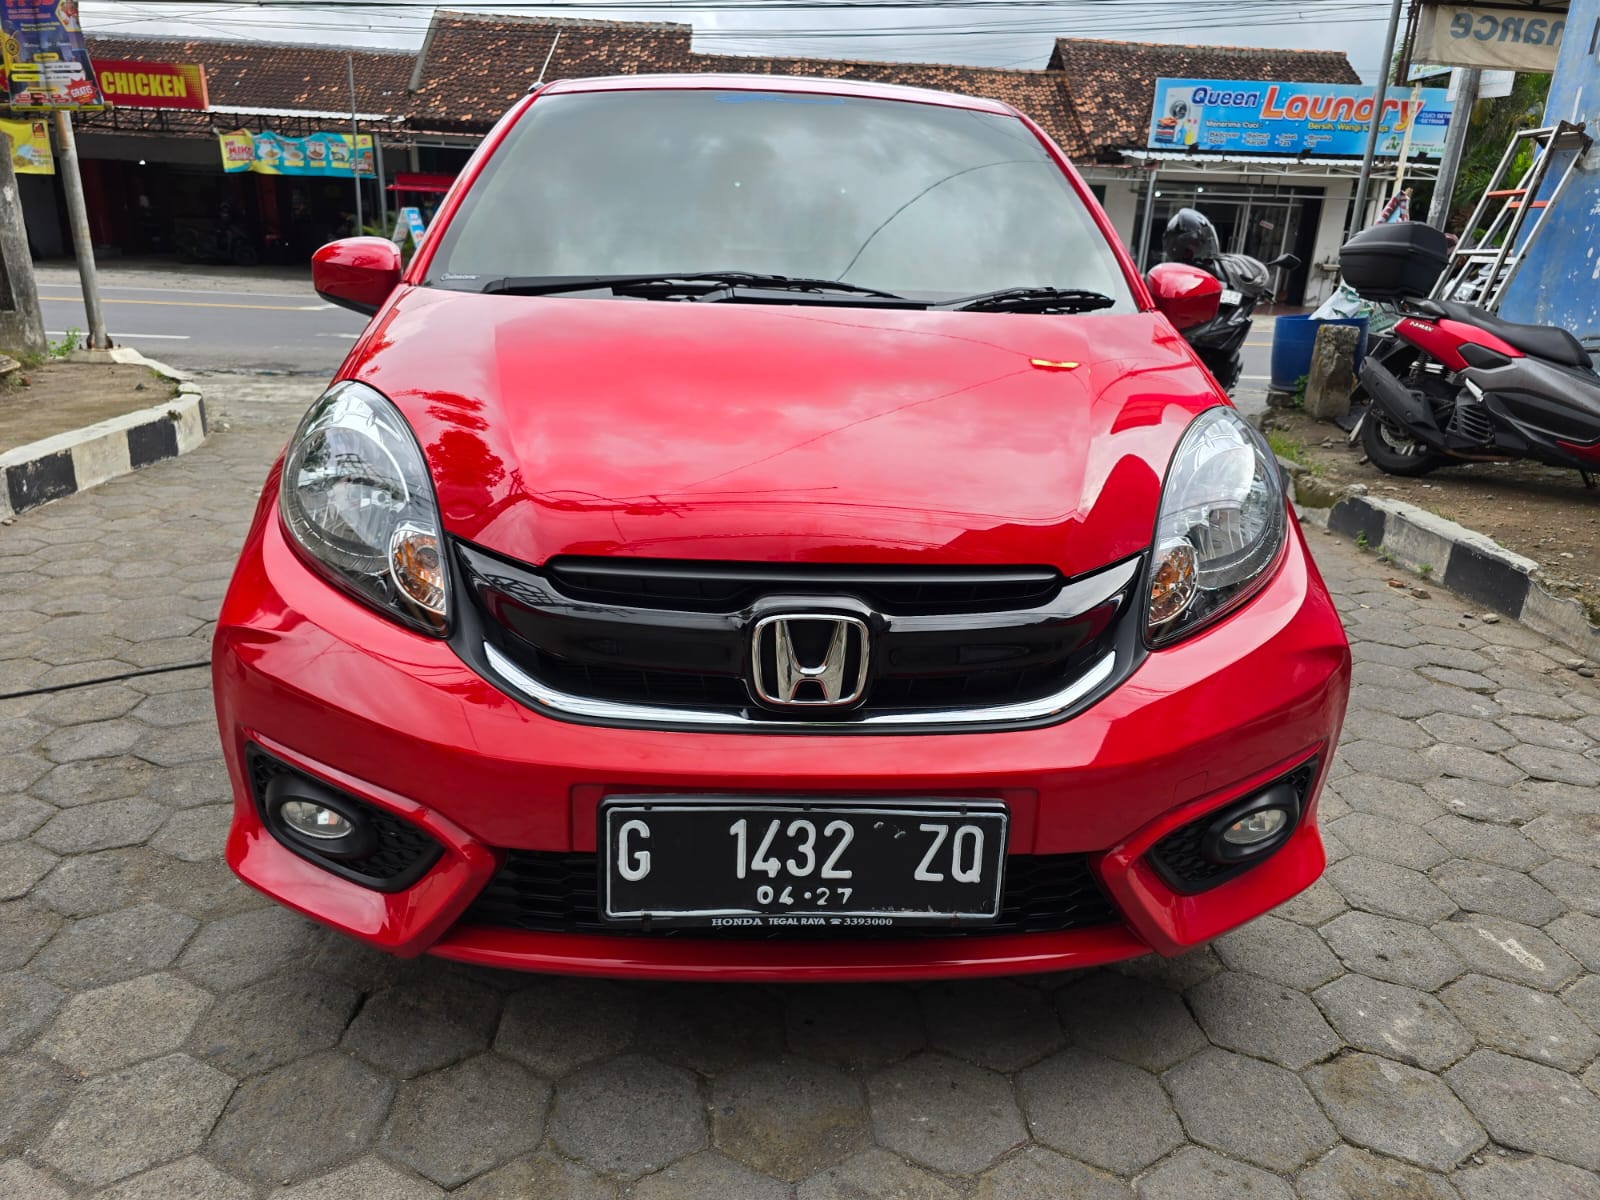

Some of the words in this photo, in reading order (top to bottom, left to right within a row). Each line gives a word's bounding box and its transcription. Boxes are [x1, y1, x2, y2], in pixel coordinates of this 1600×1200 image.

[101, 71, 187, 98] CHICKEN
[1192, 87, 1258, 107] Queen
[1261, 86, 1424, 132] Laundry
[617, 819, 651, 881] G
[729, 818, 854, 879] 1432
[914, 823, 984, 883] ZQ
[711, 918, 762, 926] HONDA
[800, 918, 826, 926] RAYA
[843, 918, 893, 926] 3393000
